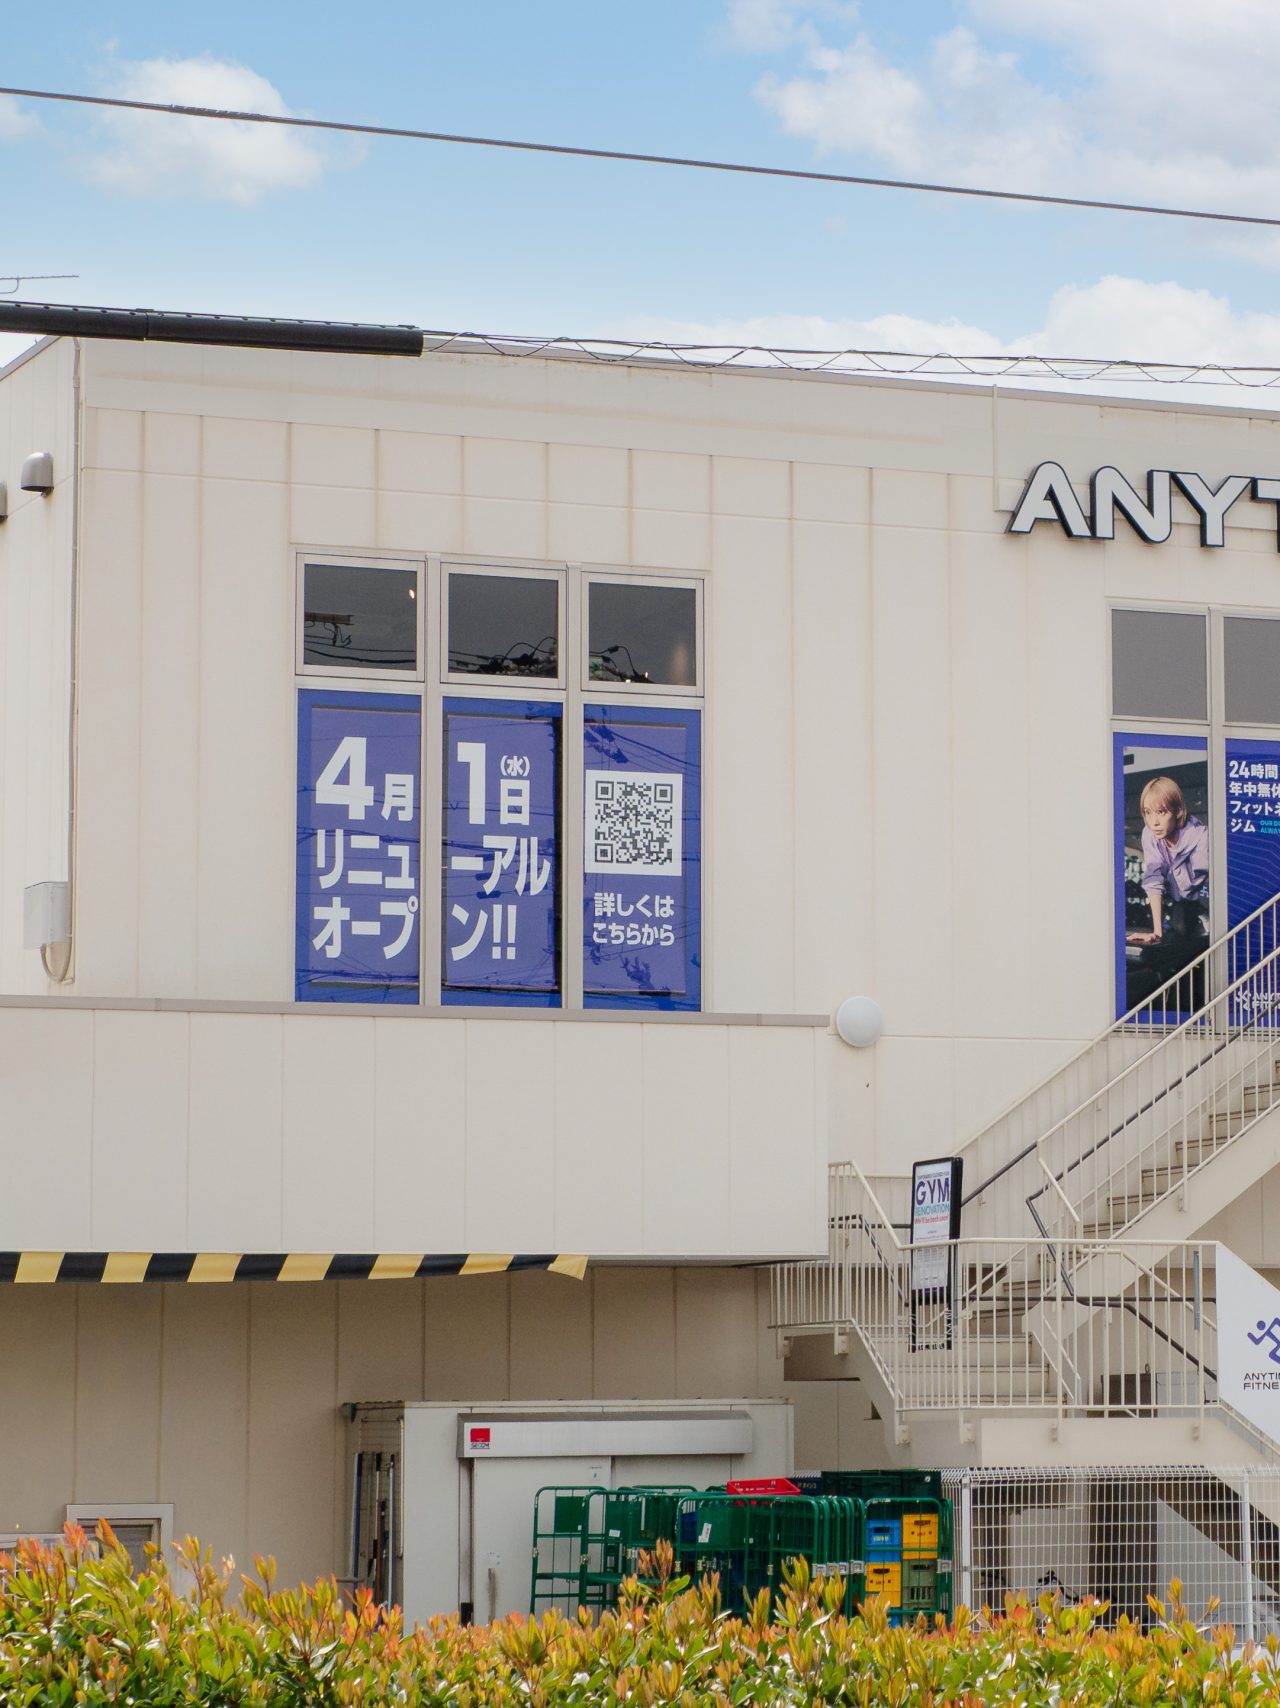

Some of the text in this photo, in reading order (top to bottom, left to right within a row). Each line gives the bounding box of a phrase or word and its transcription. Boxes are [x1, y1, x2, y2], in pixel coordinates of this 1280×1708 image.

[1229, 760, 1278, 780] 24時間
[1230, 818, 1256, 833] ジム
[592, 892, 675, 918] 詳しくは
[592, 922, 675, 947] こちらから
[916, 1177, 949, 1205] GYM
